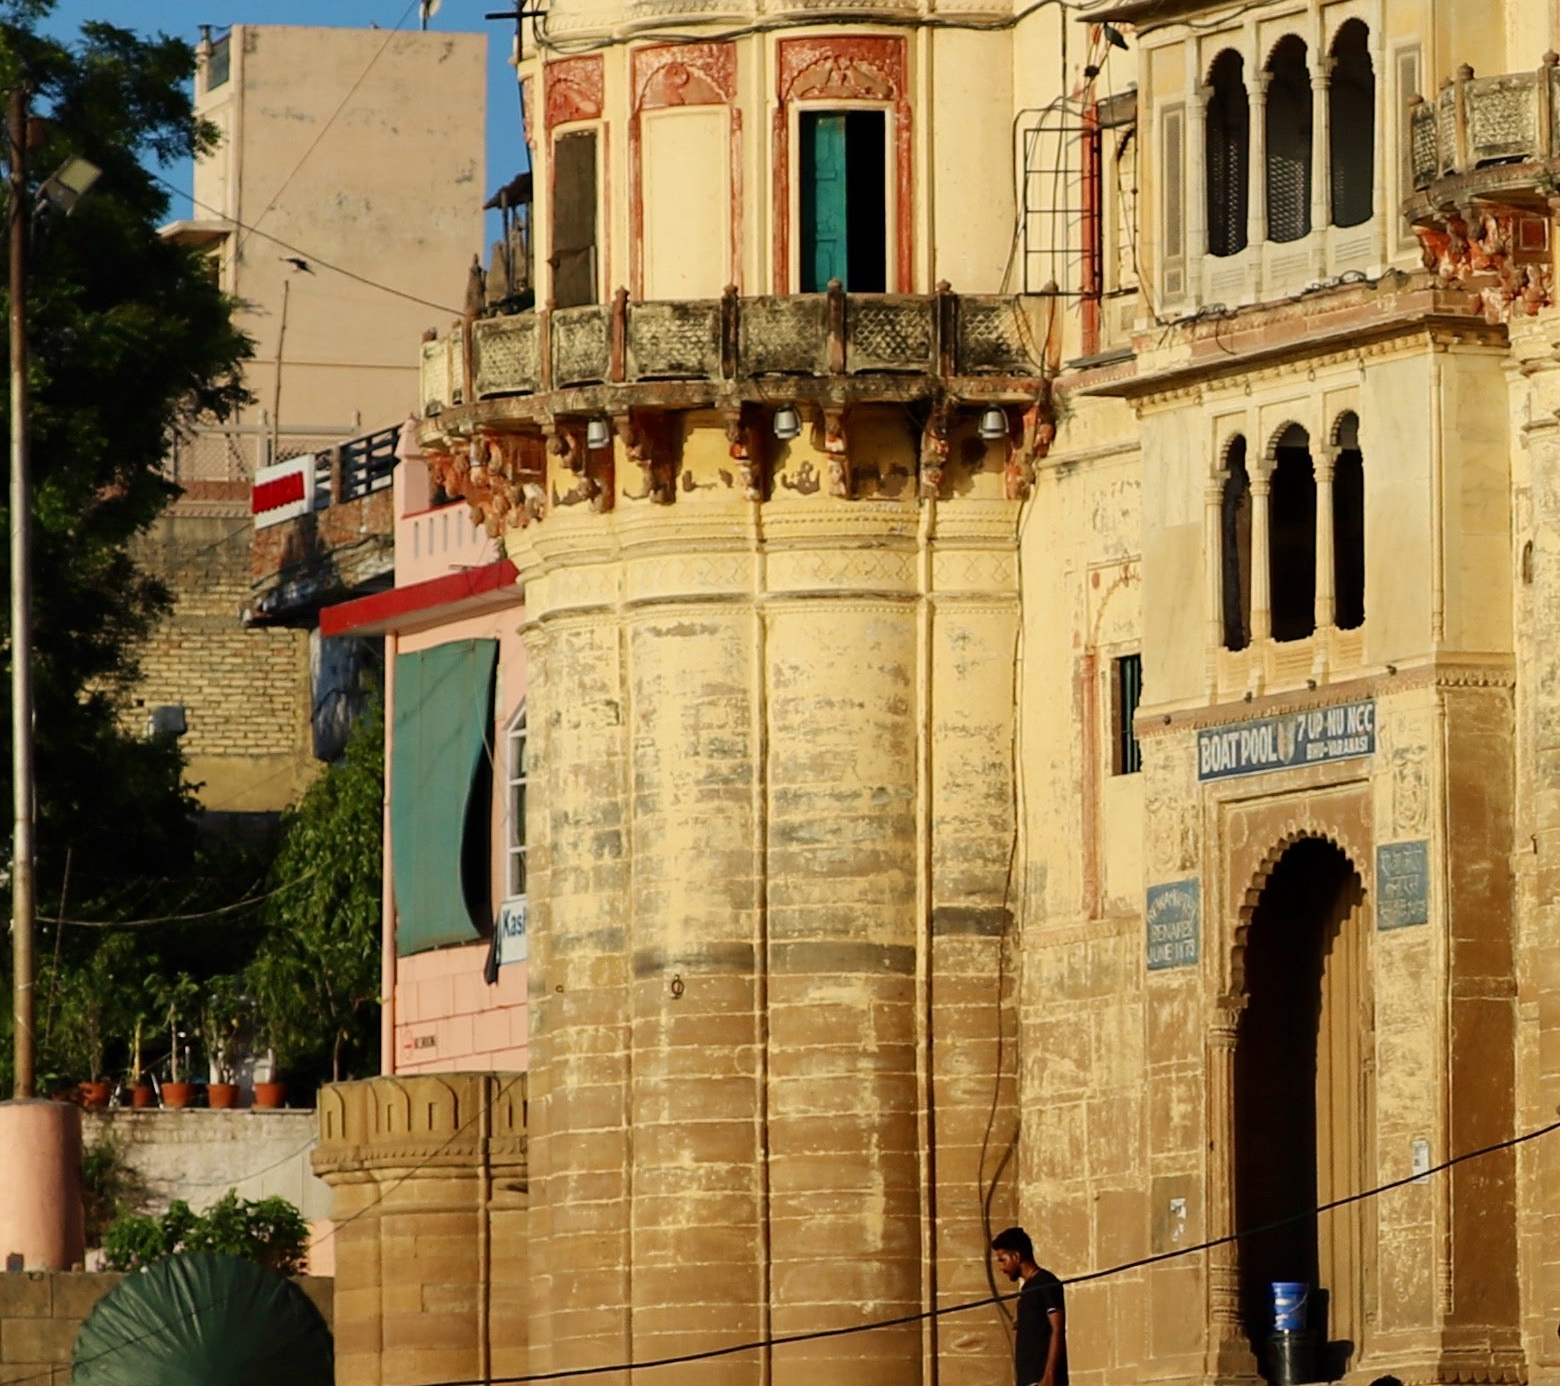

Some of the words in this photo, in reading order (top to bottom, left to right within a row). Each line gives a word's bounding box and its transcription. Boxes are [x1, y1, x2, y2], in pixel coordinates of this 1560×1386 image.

[1297, 714, 1306, 742] 7
[1347, 704, 1373, 734] NCC
[1200, 732, 1239, 774] BOAT
[1241, 725, 1277, 766] POOL
